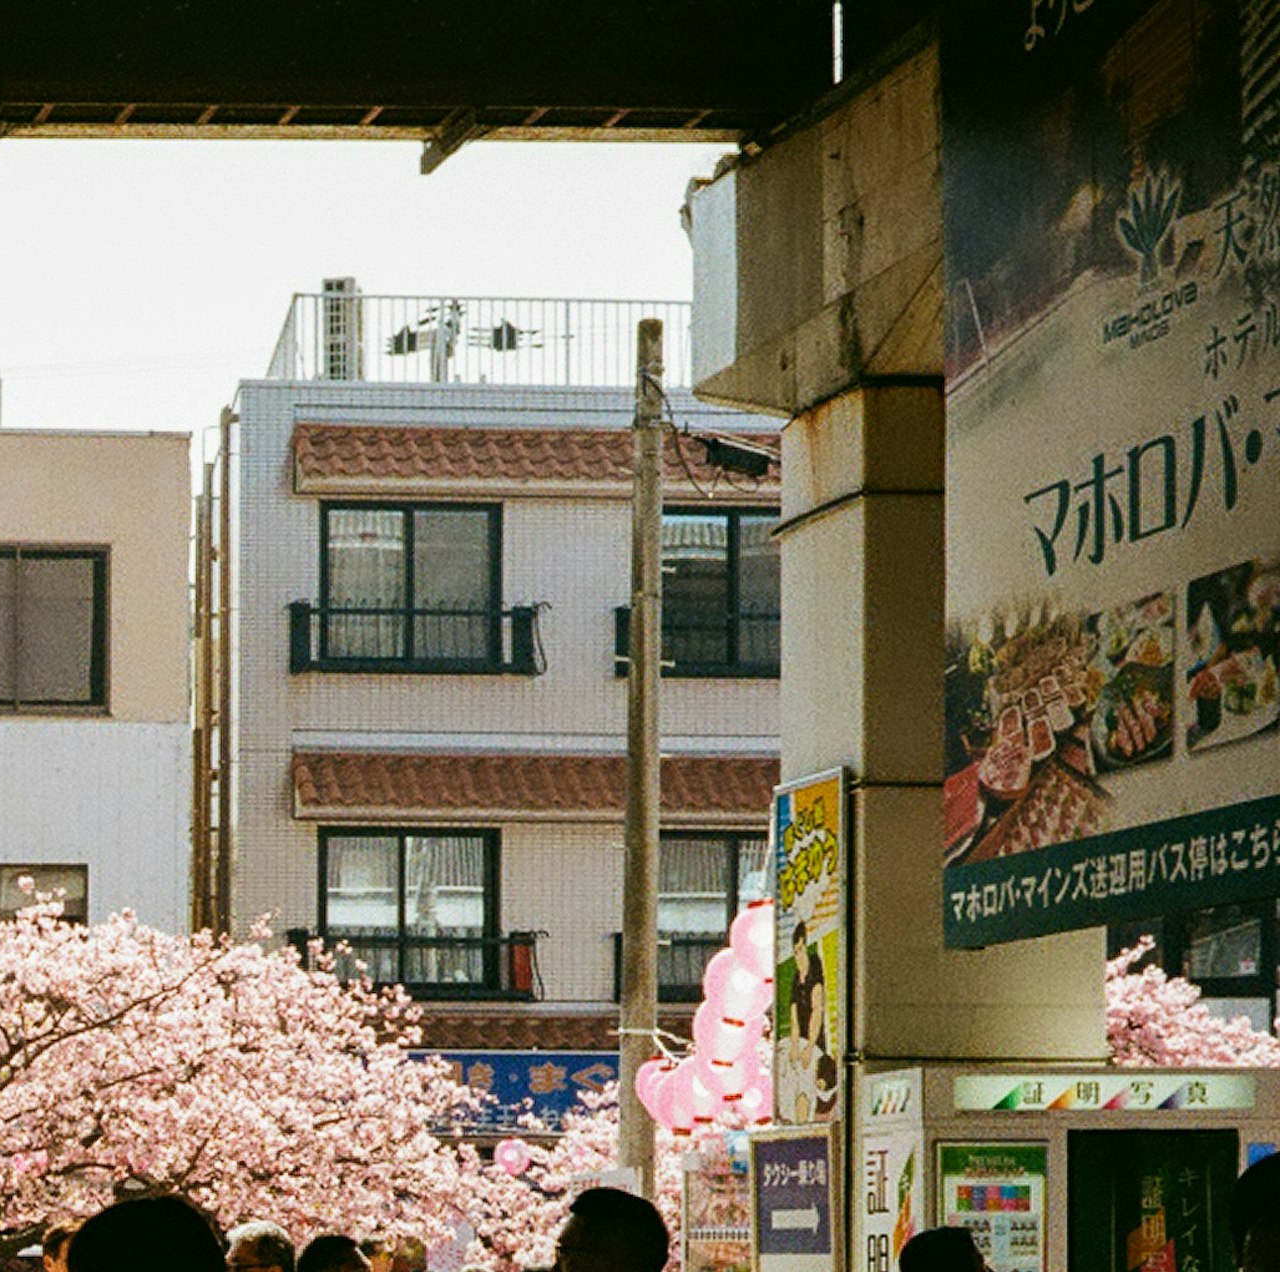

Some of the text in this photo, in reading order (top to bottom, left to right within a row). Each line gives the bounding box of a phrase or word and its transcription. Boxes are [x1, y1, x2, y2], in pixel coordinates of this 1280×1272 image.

[1024, 386, 1280, 576] マホロバ・
